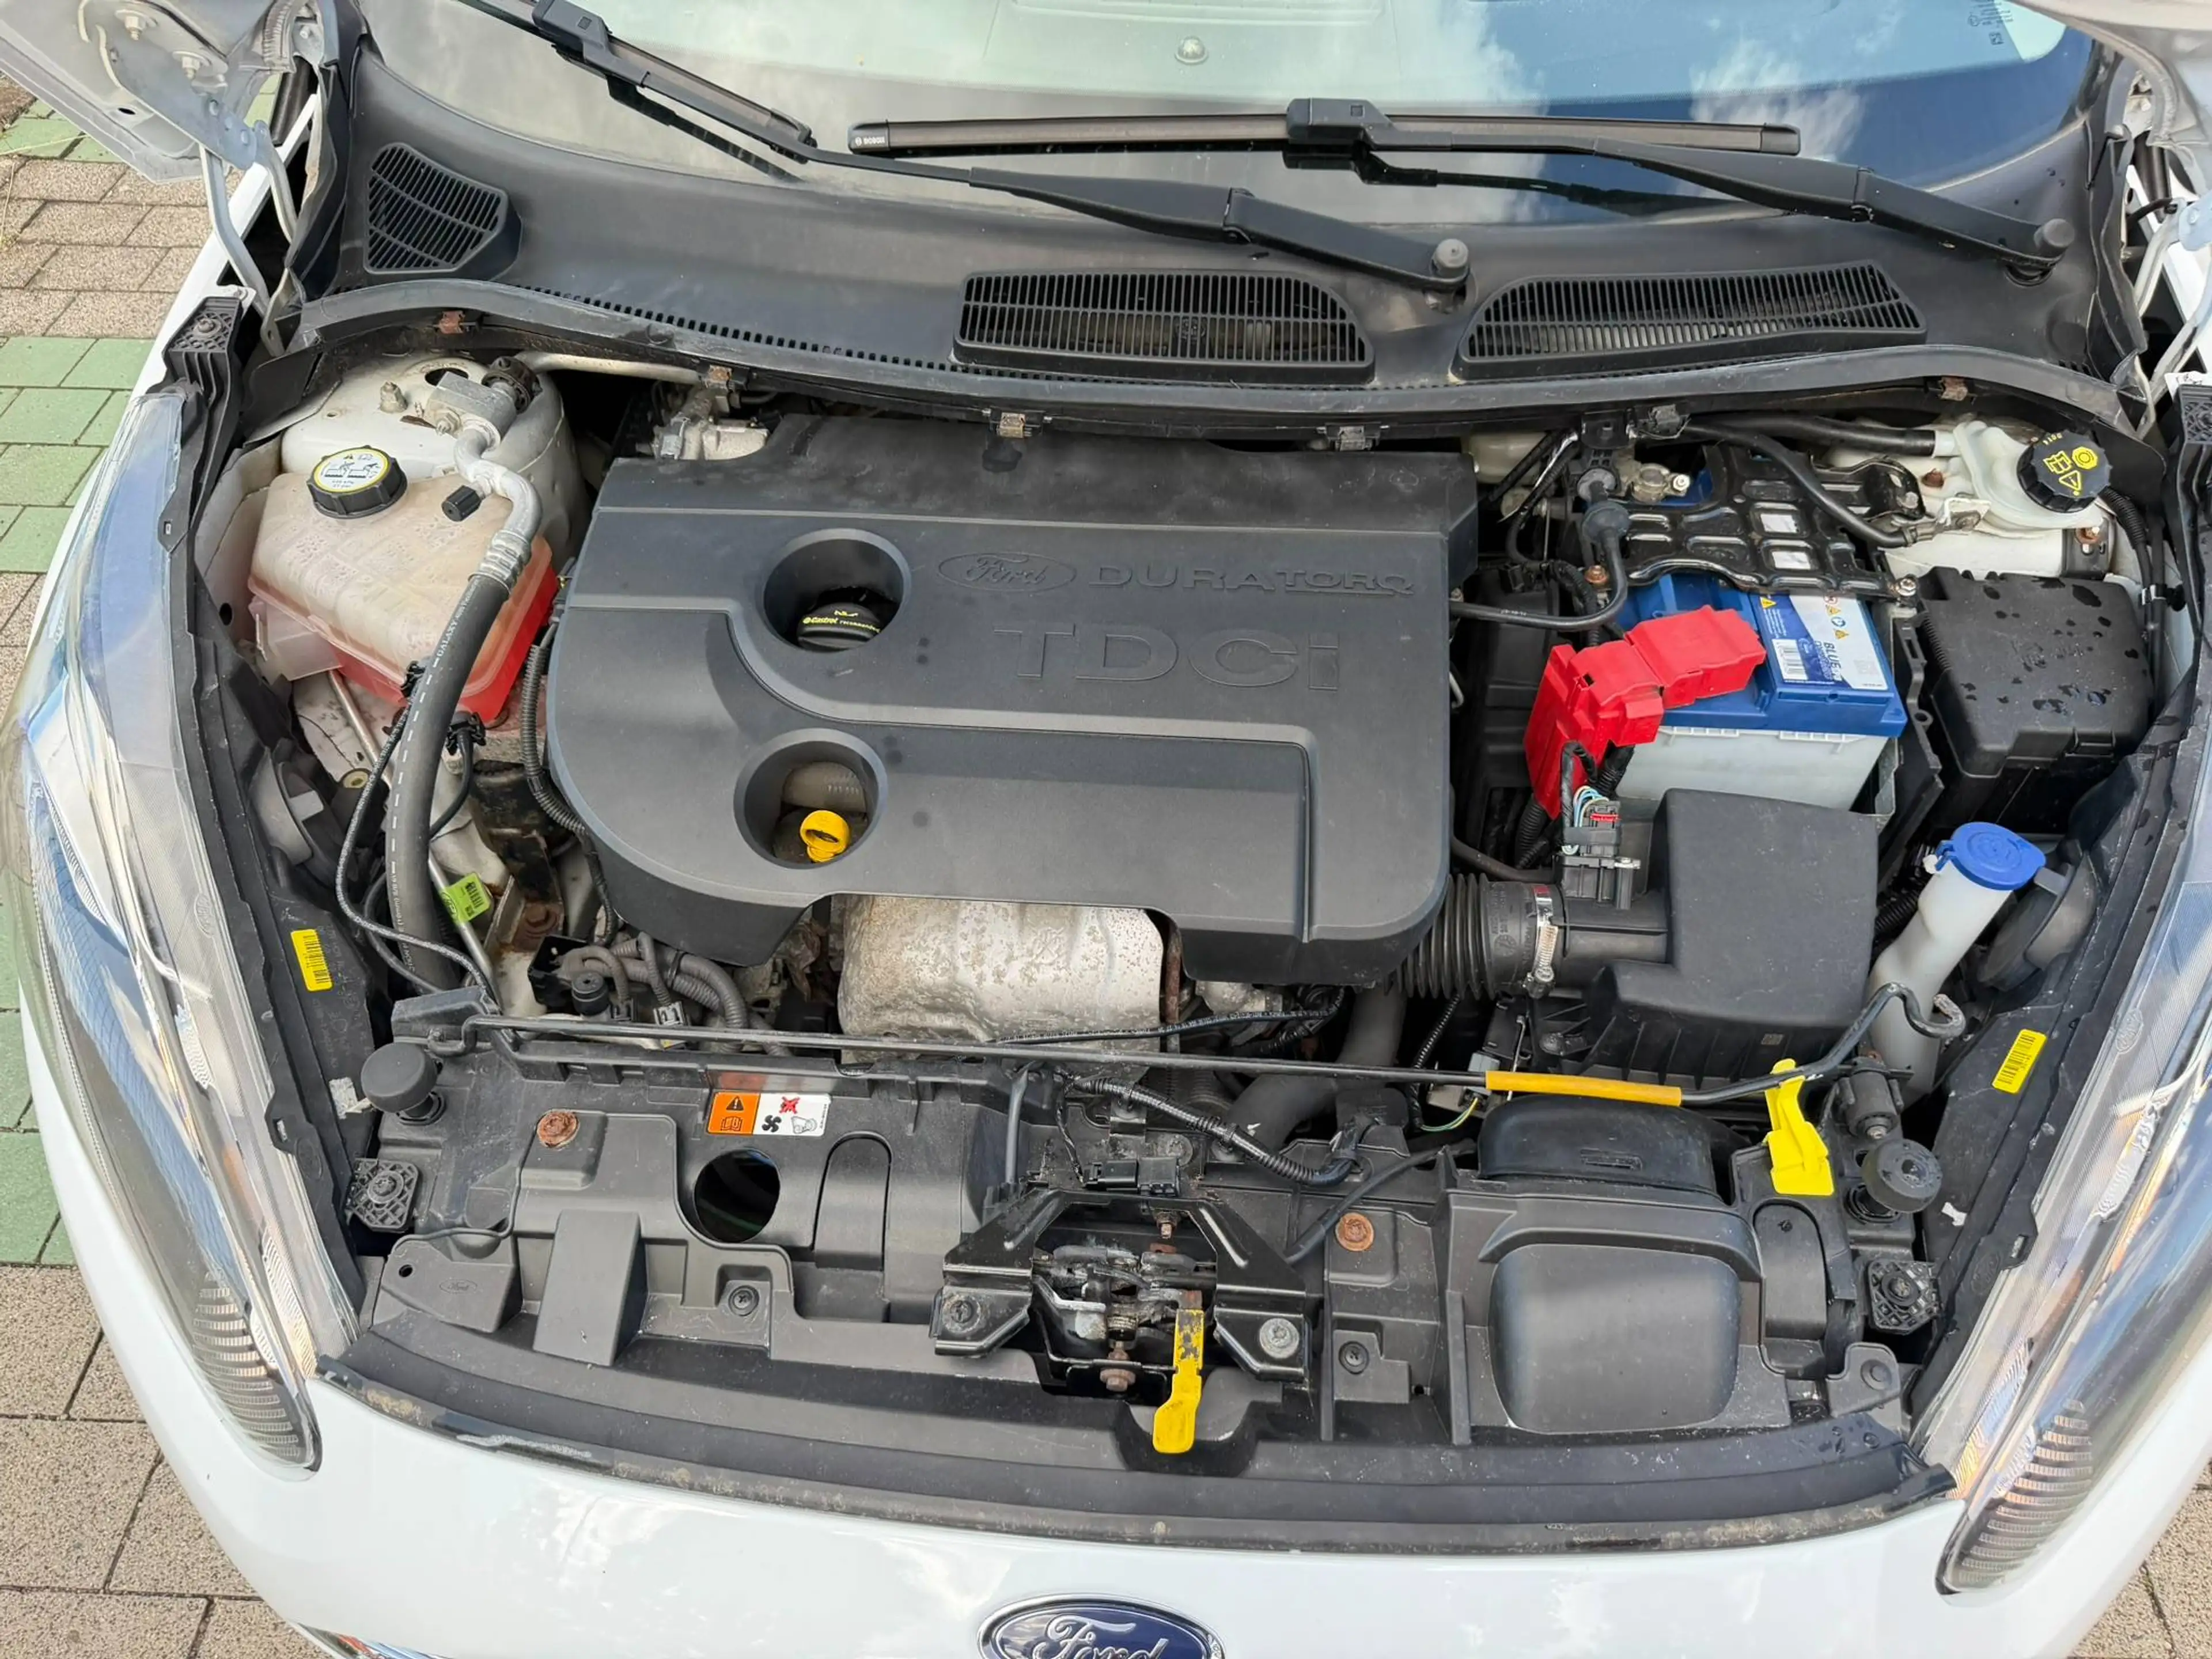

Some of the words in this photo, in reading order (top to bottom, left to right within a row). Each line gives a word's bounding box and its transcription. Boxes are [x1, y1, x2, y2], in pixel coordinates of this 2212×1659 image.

[966, 554, 1049, 585] Ford
[1089, 566, 1414, 596] DURATORQ
[993, 623, 1340, 691] TDCi
